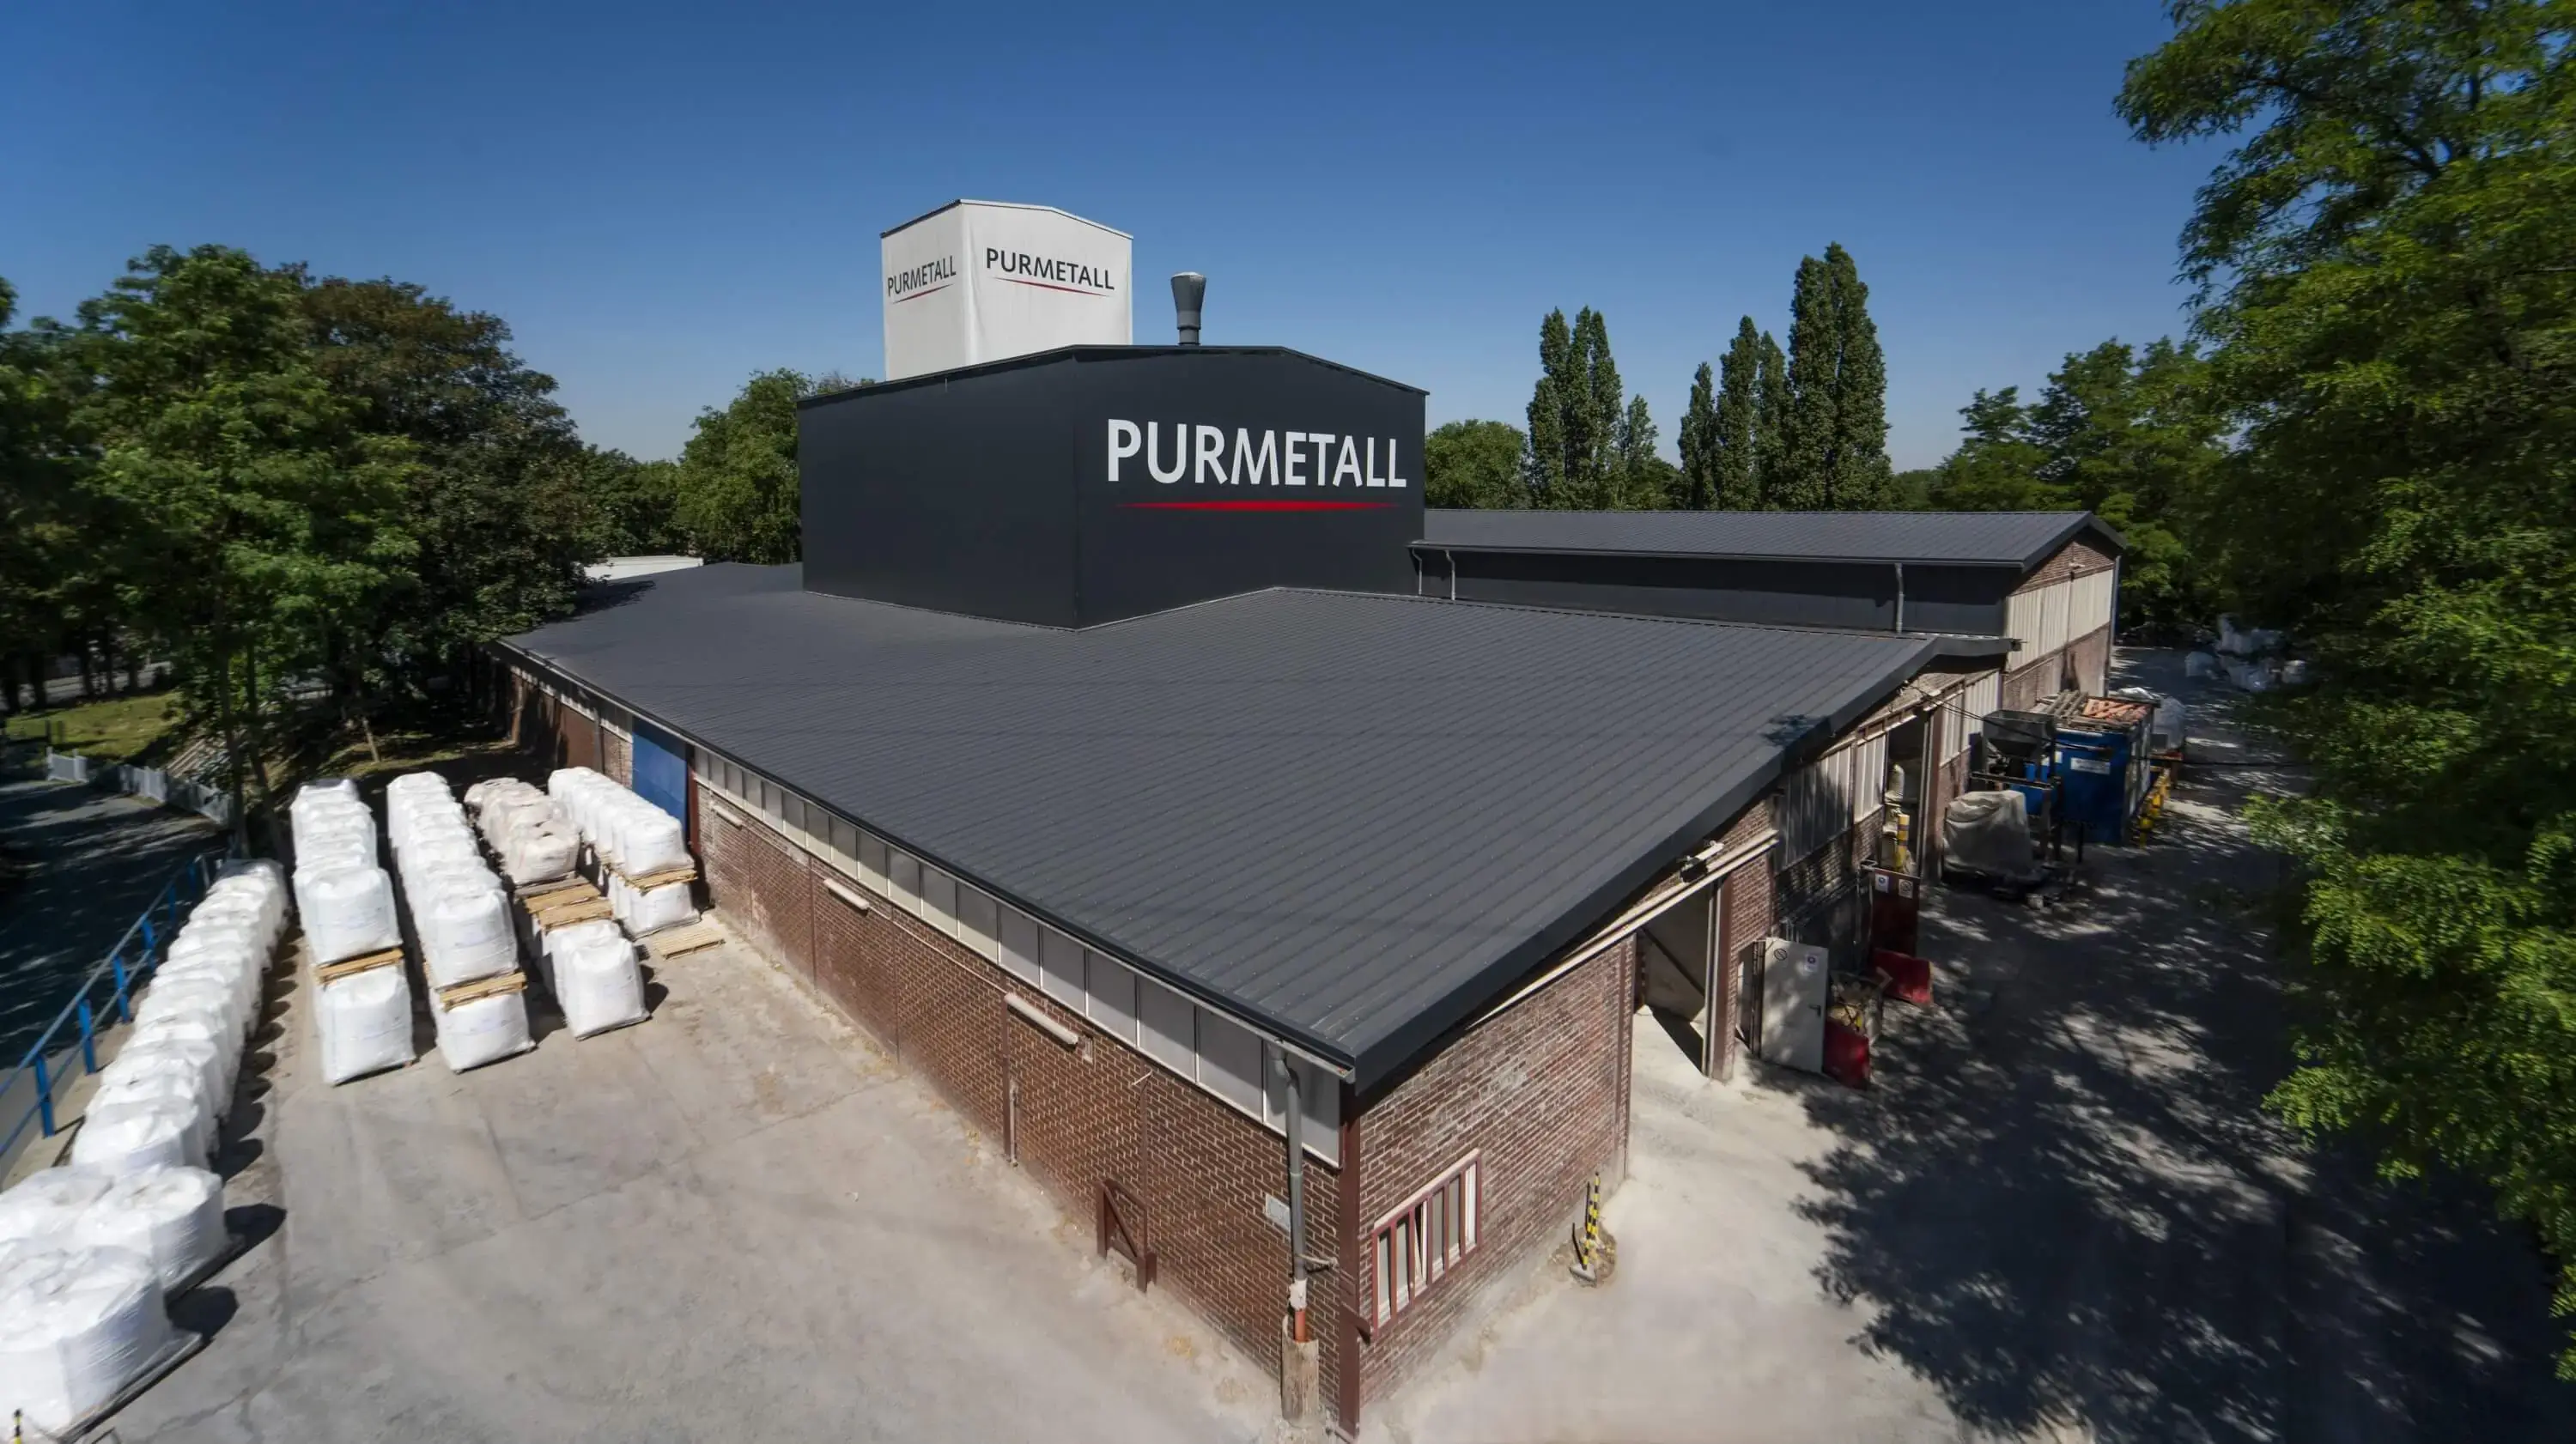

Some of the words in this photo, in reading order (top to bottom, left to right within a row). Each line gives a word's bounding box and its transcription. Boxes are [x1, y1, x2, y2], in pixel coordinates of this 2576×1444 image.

[888, 256, 957, 296] PURMETALL
[987, 247, 1115, 290] PURMETALL
[1108, 418, 1406, 488] PURMETALL
